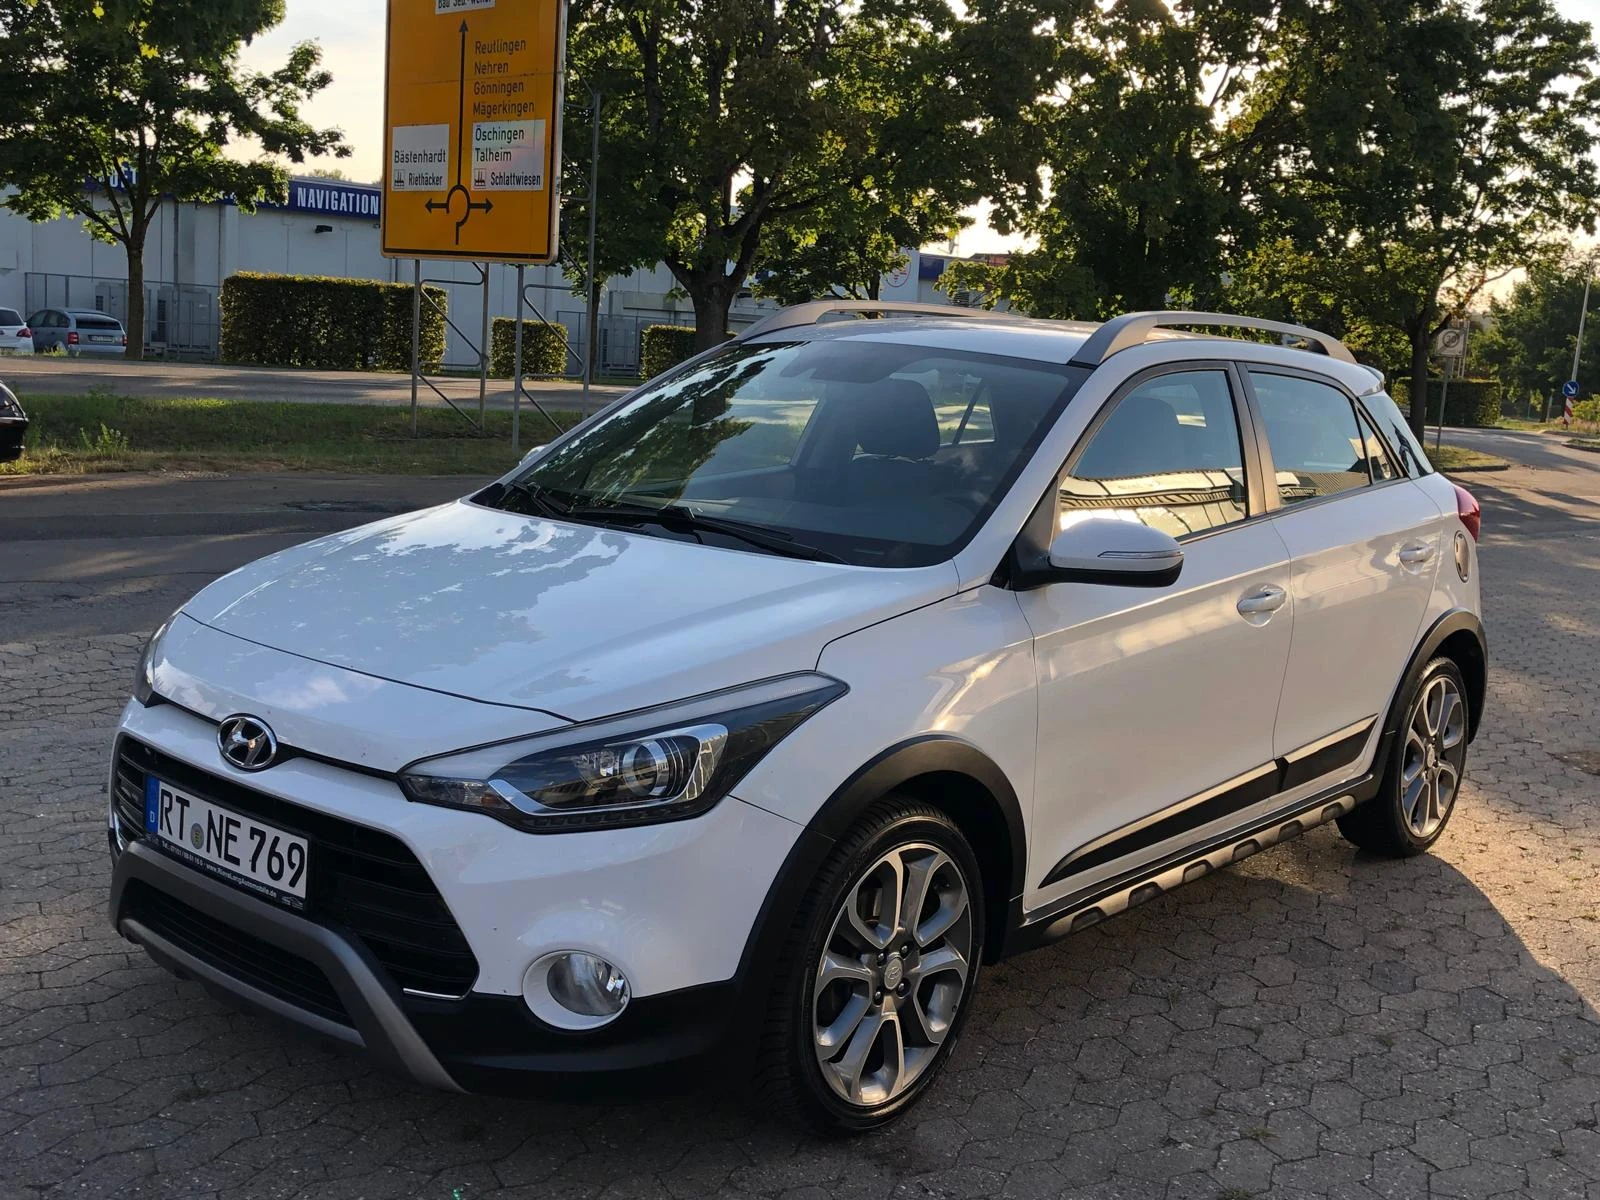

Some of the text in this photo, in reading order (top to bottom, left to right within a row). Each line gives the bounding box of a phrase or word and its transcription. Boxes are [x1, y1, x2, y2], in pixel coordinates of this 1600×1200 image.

[475, 38, 526, 55] Reutlingen
[474, 61, 509, 75] Nehren
[473, 80, 524, 97] Gönningen
[473, 101, 535, 119] Mägerkingen
[475, 124, 525, 144] Öschingen
[394, 149, 446, 164] Bästenhardt
[475, 147, 512, 162] Talheim
[408, 172, 443, 187] Riethäcker
[490, 171, 541, 187] Schlattwiesen
[297, 187, 379, 215] NAVIGATION
[150, 810, 156, 823] D
[159, 788, 306, 888] RT NE 769
